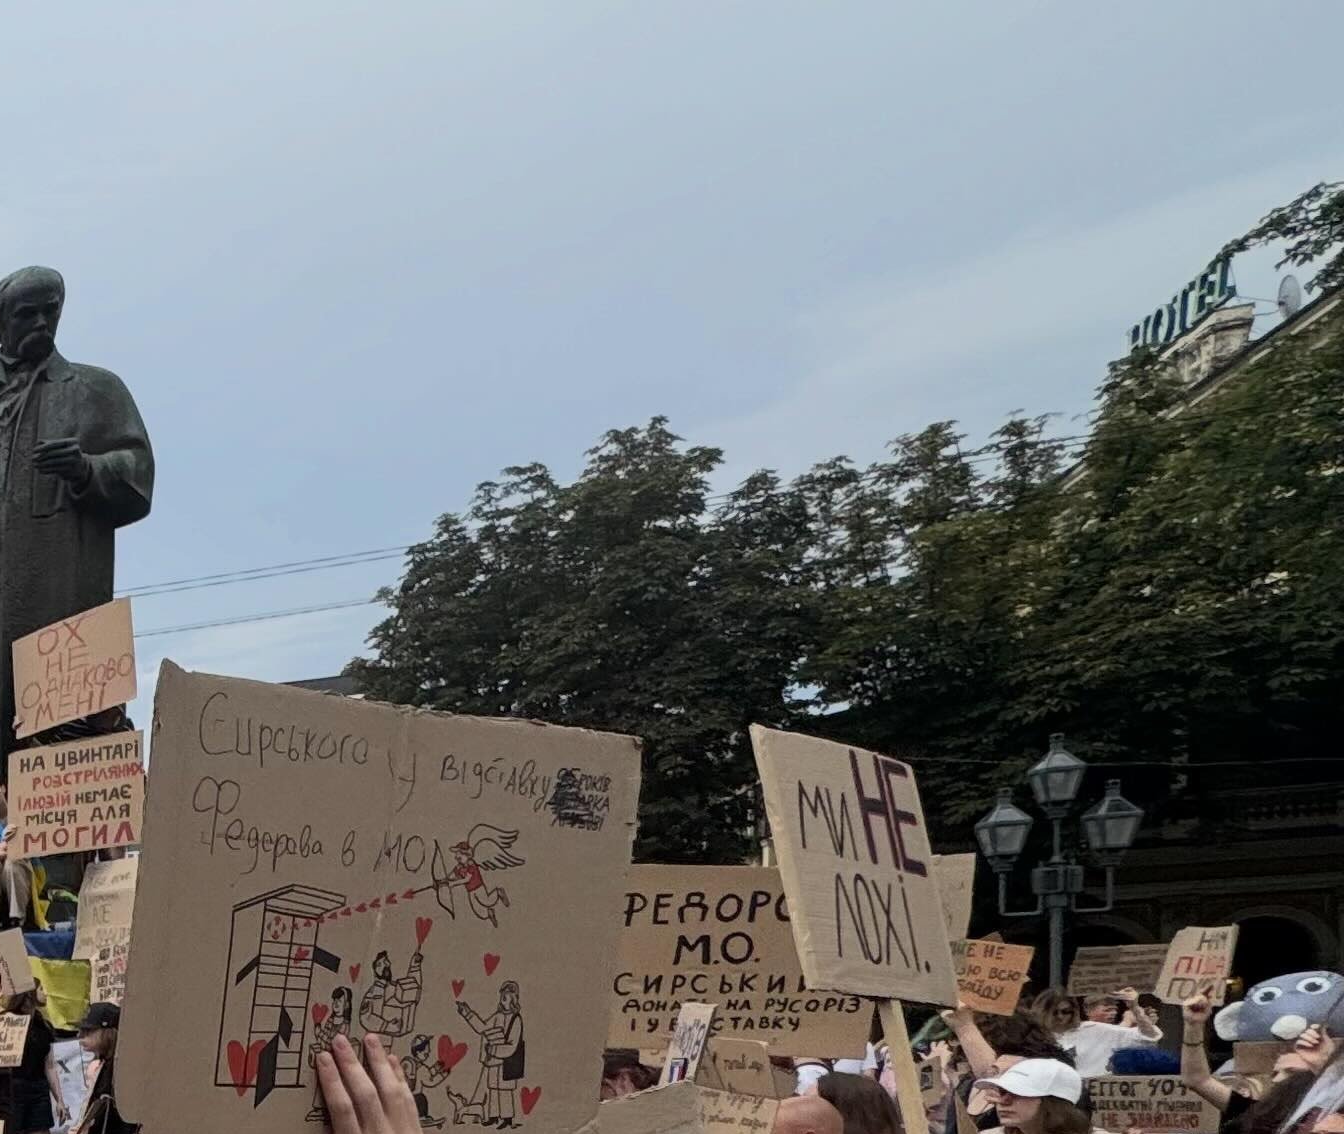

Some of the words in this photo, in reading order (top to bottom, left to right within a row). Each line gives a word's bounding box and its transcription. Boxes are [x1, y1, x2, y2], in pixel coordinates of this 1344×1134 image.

[37, 615, 87, 656] ОХ
[46, 647, 89, 679] НЕ
[21, 652, 133, 709] ОДНАКОВО
[34, 682, 106, 730] МЕНІ
[20, 756, 45, 774] НА
[54, 740, 140, 772] ЦВИНТАРІ
[32, 761, 146, 792] РОЗСТРІЛЯНИХ
[17, 789, 72, 813] ІЛЮЗІЙ
[74, 784, 133, 804] НЕМАЄ
[798, 779, 858, 861] МИ
[849, 748, 928, 877] НЕ
[25, 806, 79, 828] МІСЦЯ
[23, 820, 136, 854] МОГИЛ
[836, 874, 932, 974] ЛОХІ.
[673, 932, 762, 966] М.О.
[726, 1000, 752, 1011] НА
[764, 997, 862, 1014] РУСОРІЗ
